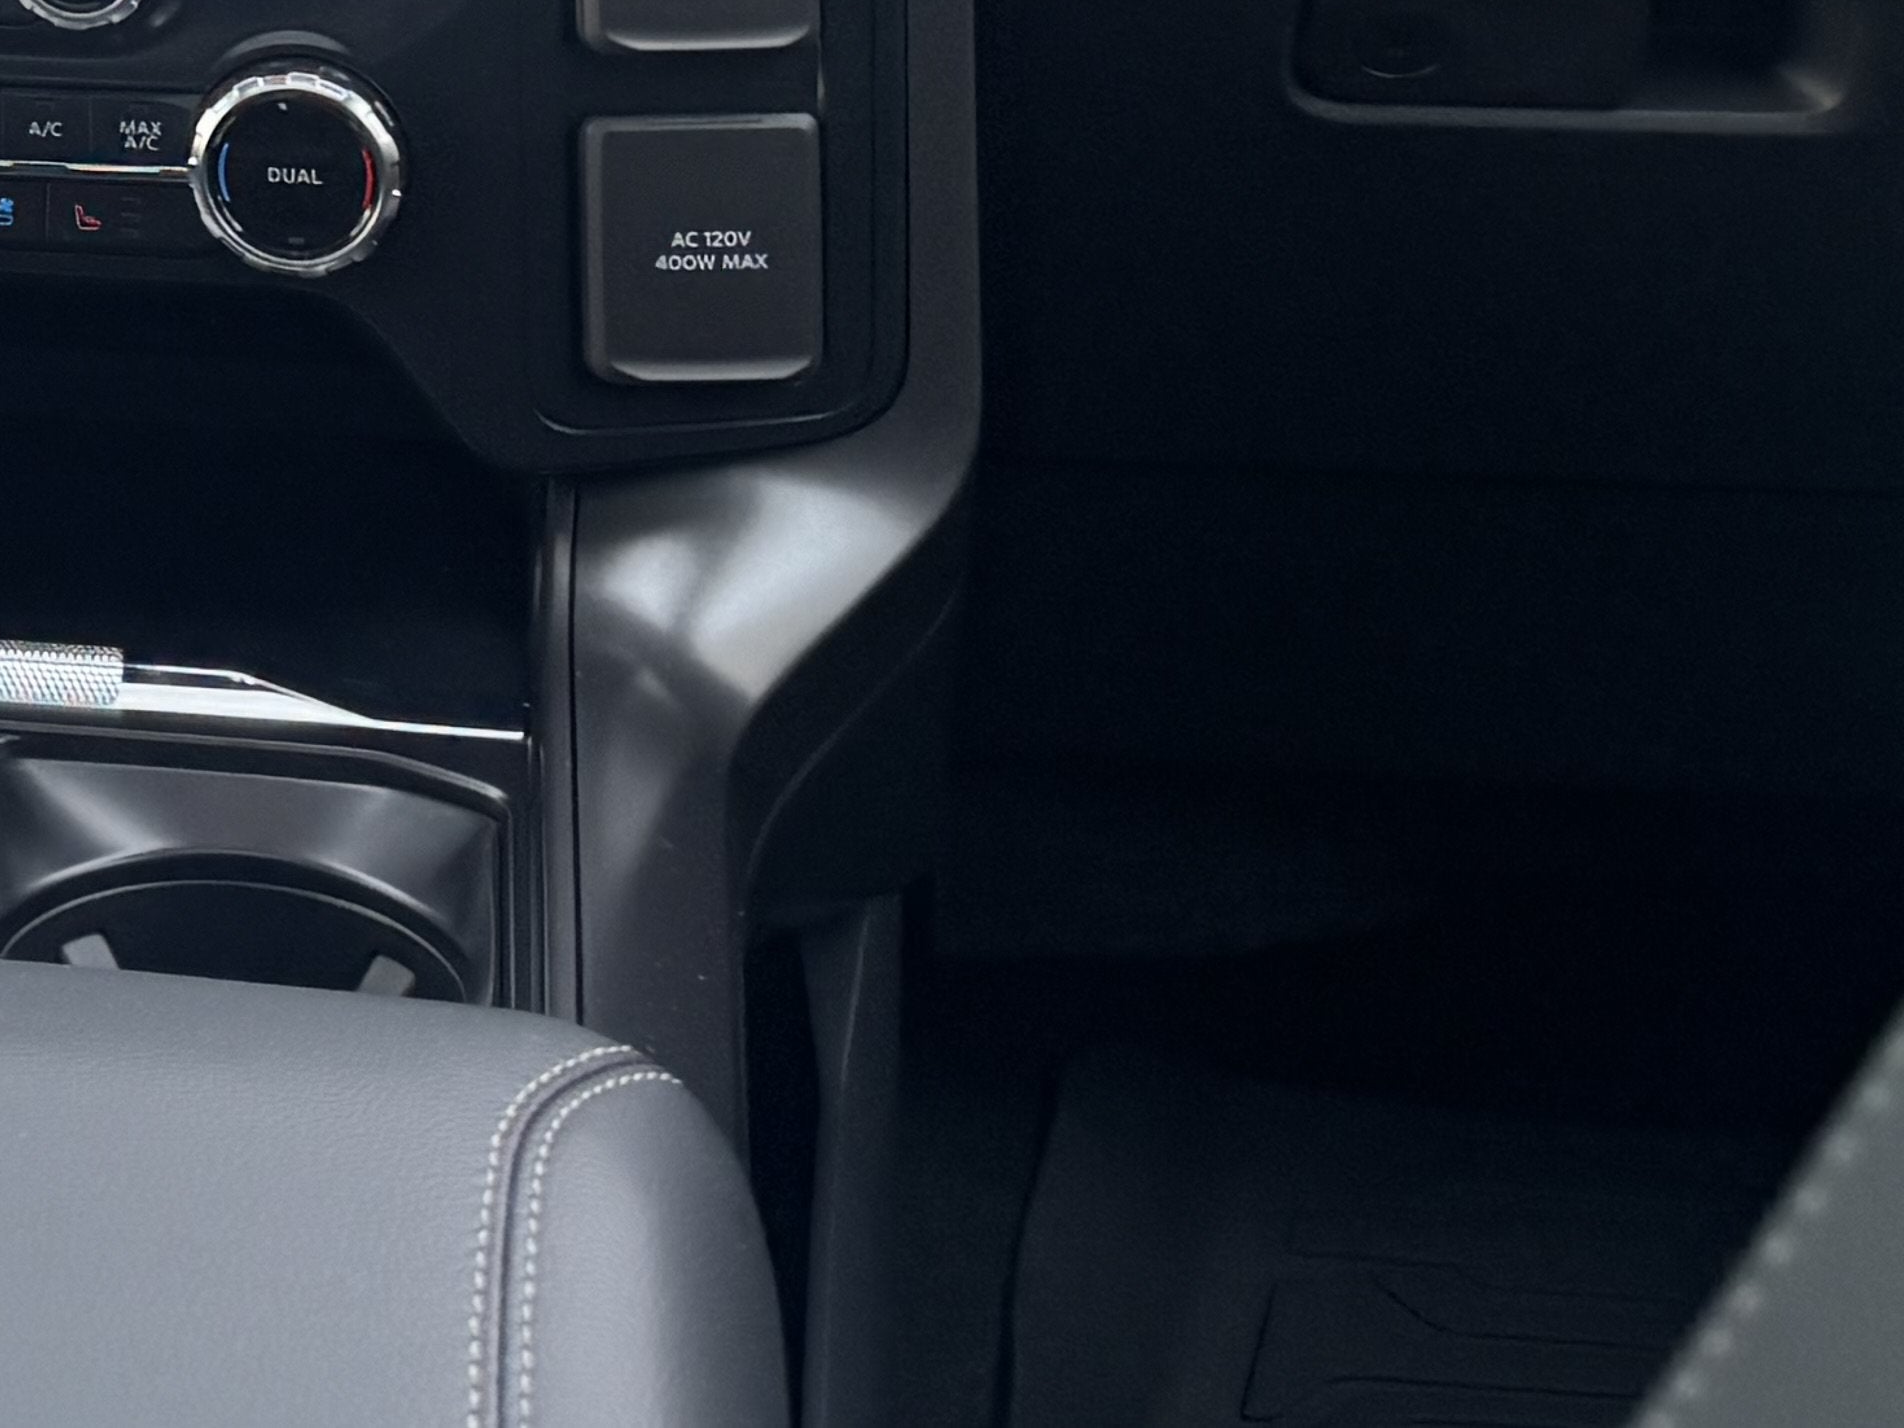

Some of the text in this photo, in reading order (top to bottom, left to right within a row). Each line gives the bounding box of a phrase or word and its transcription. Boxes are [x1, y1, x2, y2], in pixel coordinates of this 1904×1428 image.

[28, 120, 63, 138] A/C
[119, 119, 163, 137] MAX
[123, 134, 160, 152] A/C
[267, 166, 324, 185] DUAL
[671, 231, 752, 249] AC 120V
[654, 252, 769, 272] 400W MAX
